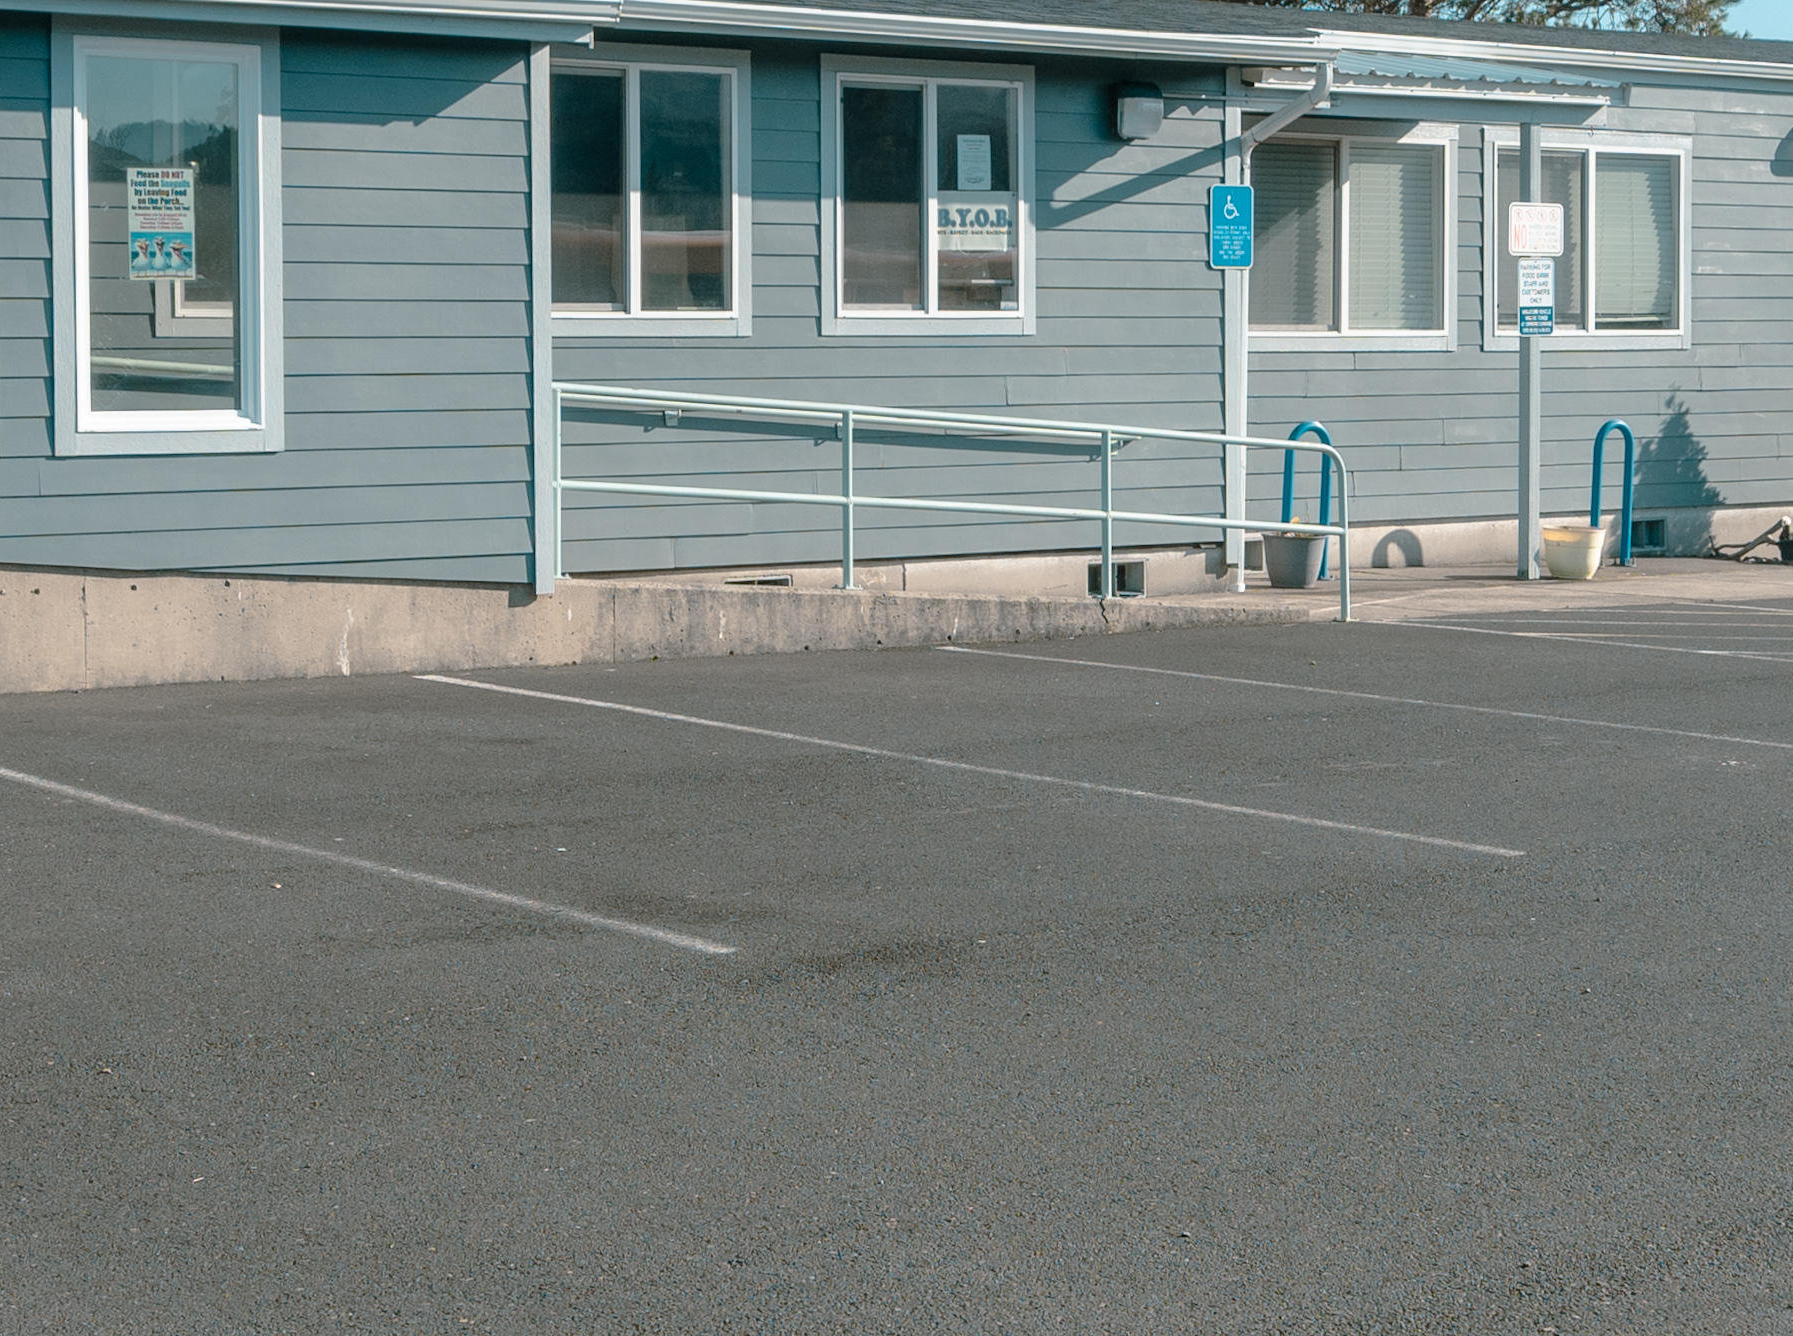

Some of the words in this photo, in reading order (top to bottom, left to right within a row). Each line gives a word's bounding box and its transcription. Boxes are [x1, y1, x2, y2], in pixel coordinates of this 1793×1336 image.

[172, 171, 184, 179] NOT
[131, 179, 146, 187] Feed
[937, 208, 1013, 228] B.Y.O.B.
[1514, 224, 1527, 249] NO
